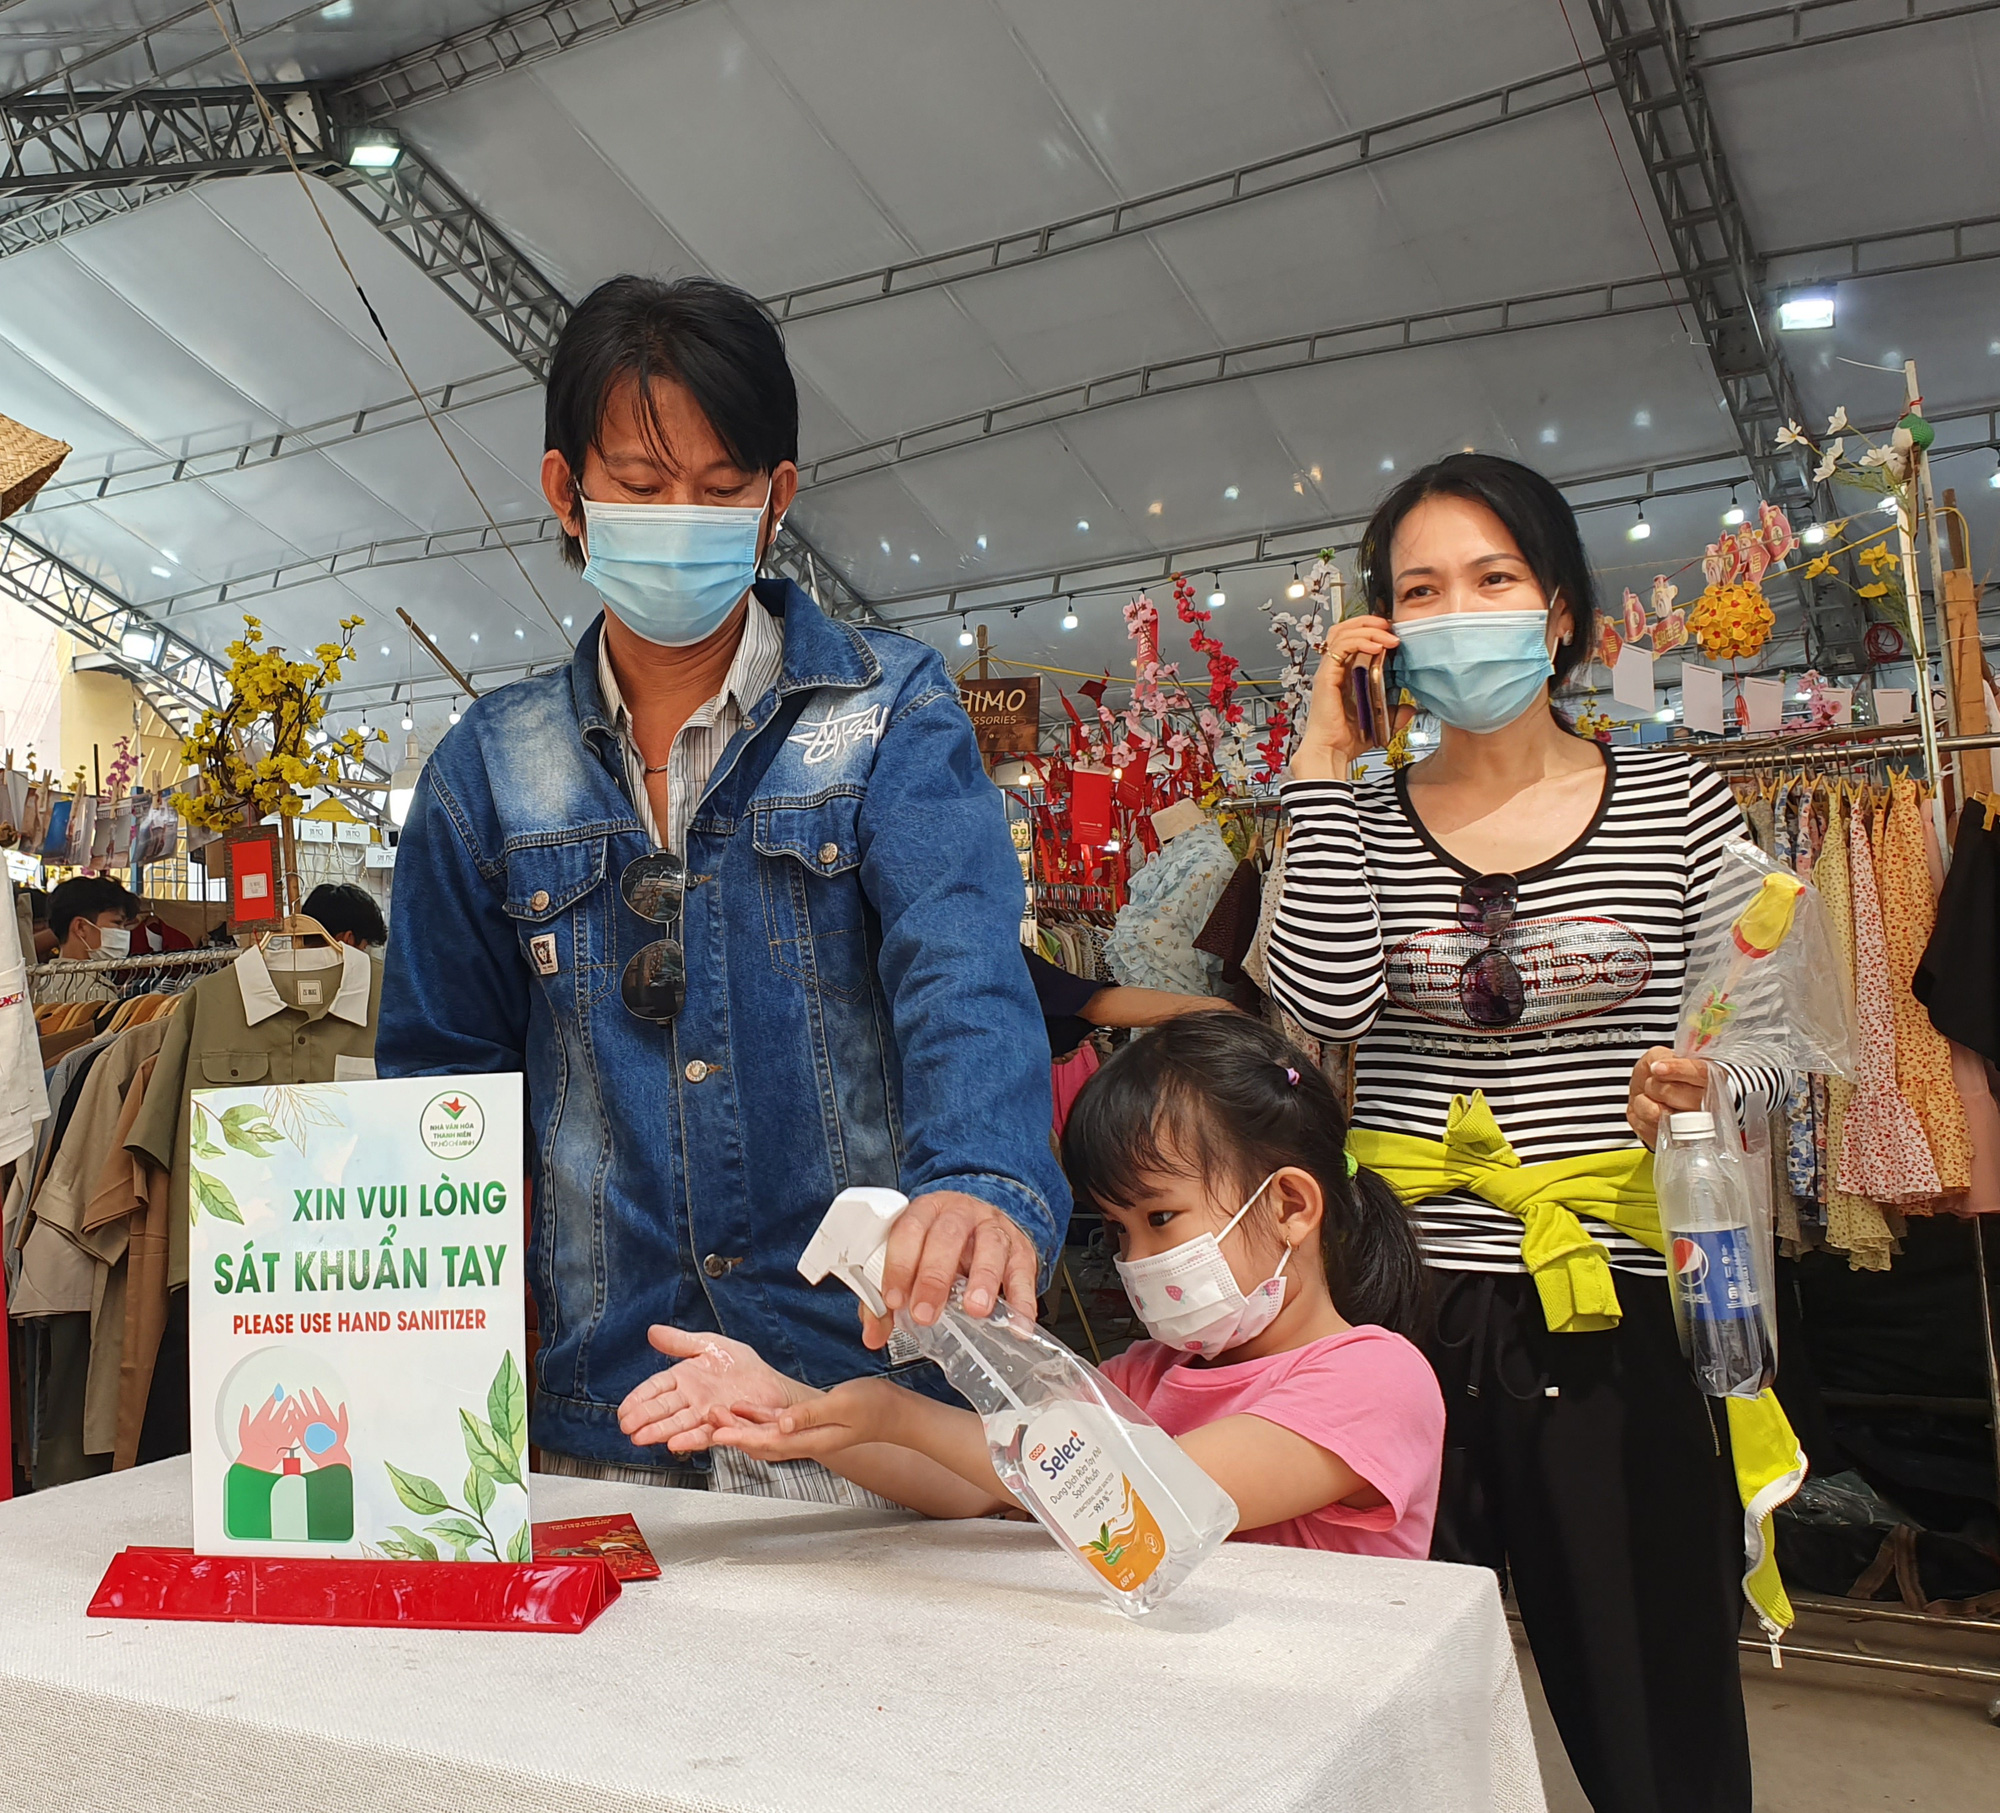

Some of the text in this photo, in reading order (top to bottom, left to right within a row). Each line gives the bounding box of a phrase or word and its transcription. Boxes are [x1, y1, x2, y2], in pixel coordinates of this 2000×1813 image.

[961, 689, 1026, 712] HIMO
[970, 715, 1017, 725] SSORIES
[1534, 1025, 1643, 1052] Jeans
[292, 1173, 507, 1222] XIN VUI LÒNG
[214, 1223, 508, 1294] SÁT KHUẨN TAY
[233, 1309, 486, 1334] PLEASE USE HAND SANITIZER
[1040, 1429, 1086, 1480] Select
[1049, 1488, 1068, 1504] Dung
[1064, 1474, 1079, 1490] Dịch
[1072, 1483, 1088, 1499] Sạch
